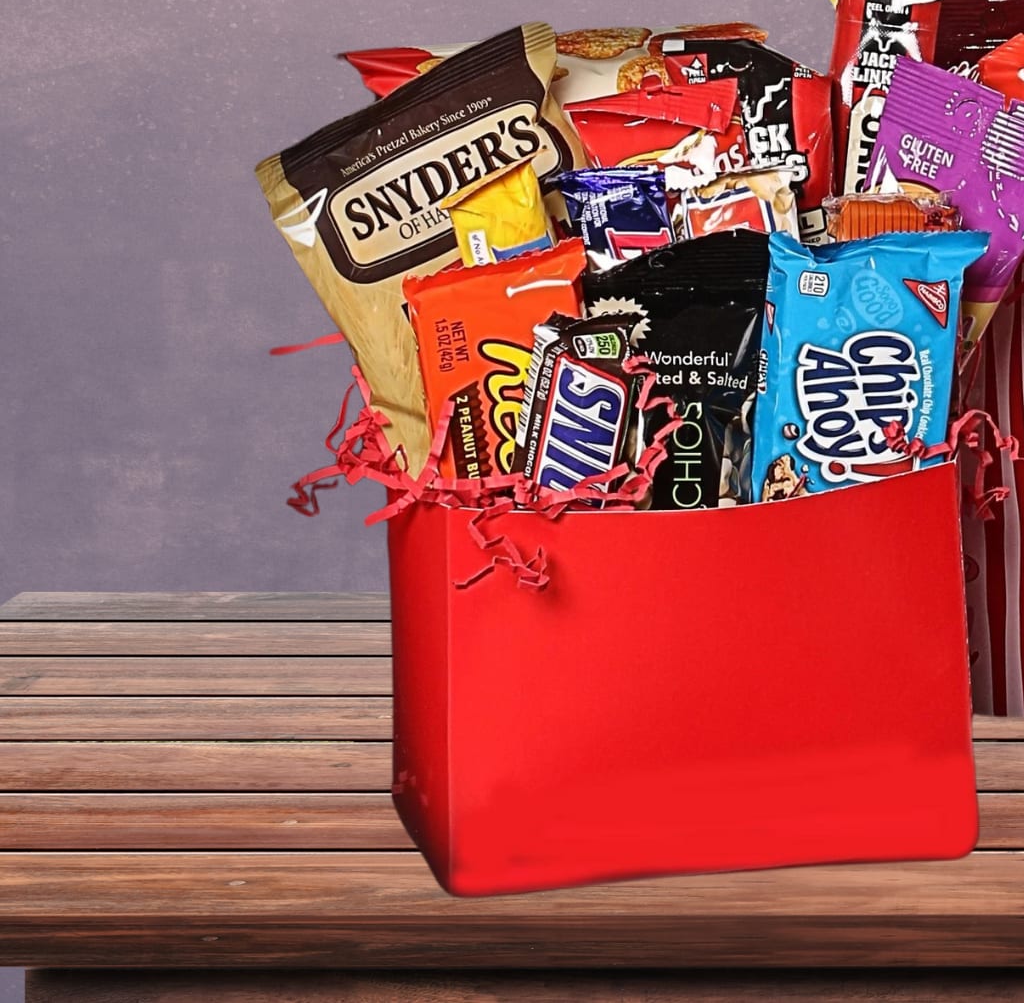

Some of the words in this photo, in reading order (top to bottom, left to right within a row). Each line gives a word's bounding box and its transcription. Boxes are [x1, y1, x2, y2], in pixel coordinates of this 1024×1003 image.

[340, 147, 377, 178] America's
[376, 133, 409, 158] Pretzel
[409, 119, 441, 141] Bakery
[440, 109, 466, 126] Since
[900, 133, 955, 168] GLUTEN
[345, 115, 541, 241] SNYDER'S
[904, 155, 939, 180] FREE
[399, 216, 422, 240] OF
[813, 275, 826, 294] 210
[435, 318, 449, 334] 1.5
[451, 321, 467, 343] NET
[437, 334, 451, 347] OZ
[597, 335, 611, 355] 250
[436, 347, 455, 373] (42g)
[454, 344, 470, 363] WT
[644, 351, 729, 367] Wonderful
[689, 372, 702, 385] &
[707, 371, 748, 390] Salted
[921, 365, 933, 399] Chocolate
[456, 395, 468, 404] 2
[920, 399, 932, 415] Chip
[458, 407, 477, 459] PEANUT
[530, 413, 542, 439] MILK
